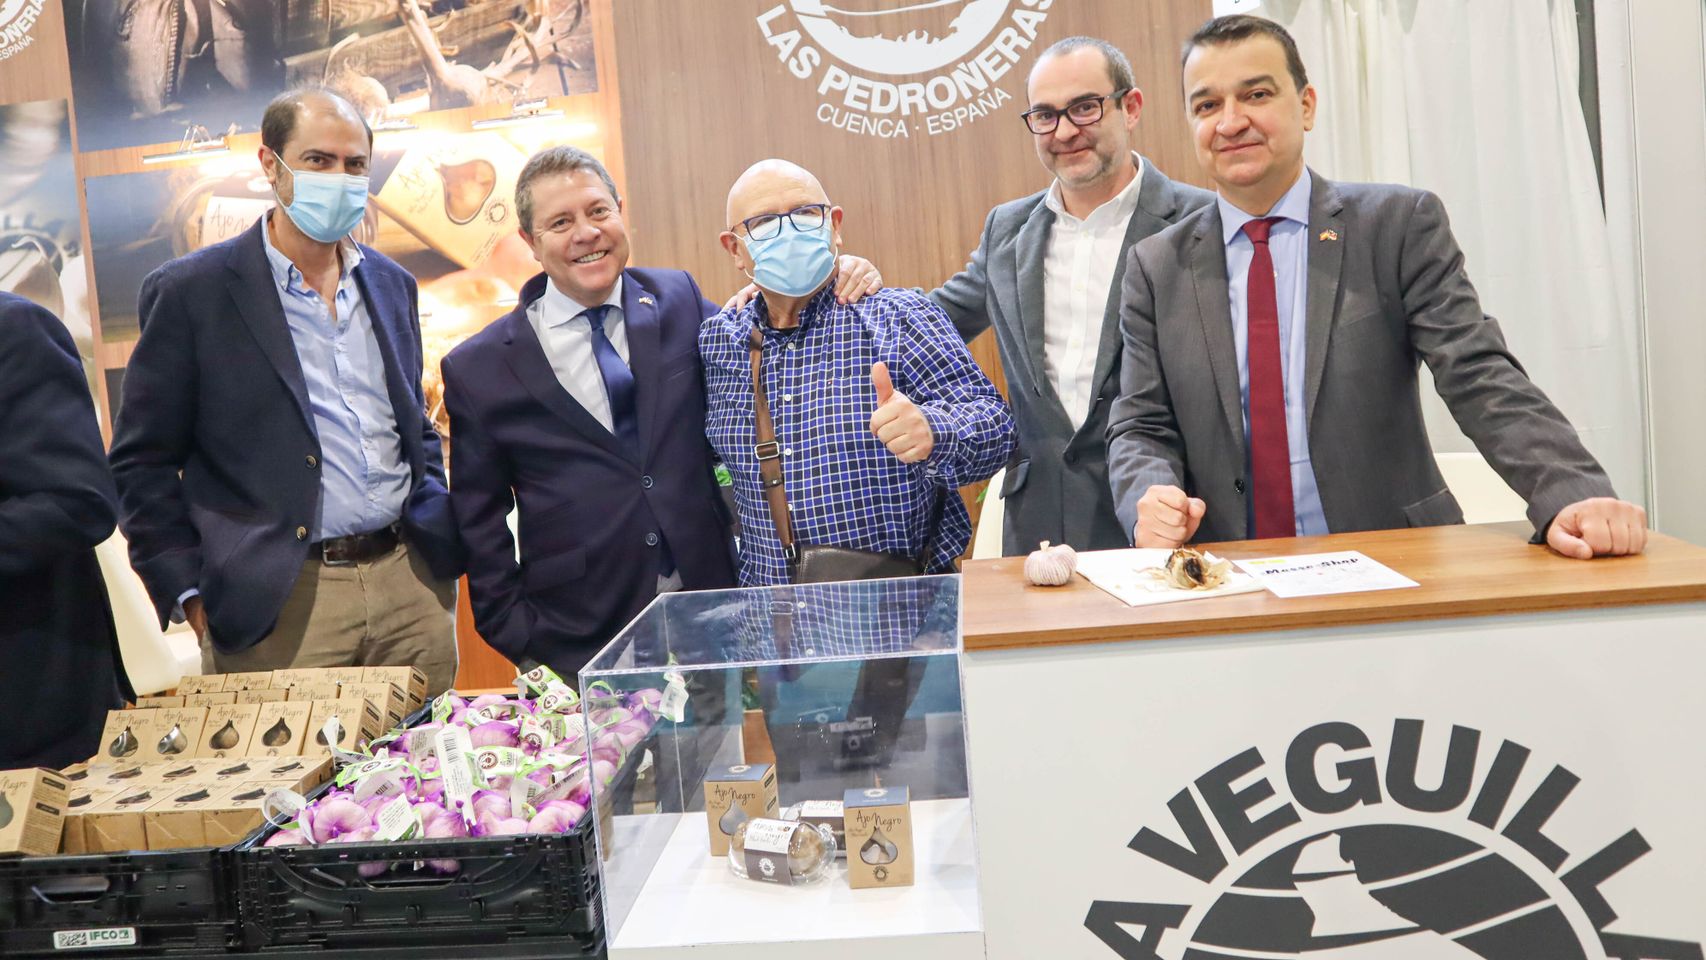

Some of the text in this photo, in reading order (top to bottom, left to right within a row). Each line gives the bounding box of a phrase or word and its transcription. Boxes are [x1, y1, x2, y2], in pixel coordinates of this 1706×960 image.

[756, 4, 821, 79] LAS
[816, 87, 1012, 138] CUENCA ESPAÑA
[728, 787, 756, 806] Negro
[856, 811, 871, 828] Ajo
[871, 812, 902, 832] Negro
[89, 930, 118, 941] IFCO
